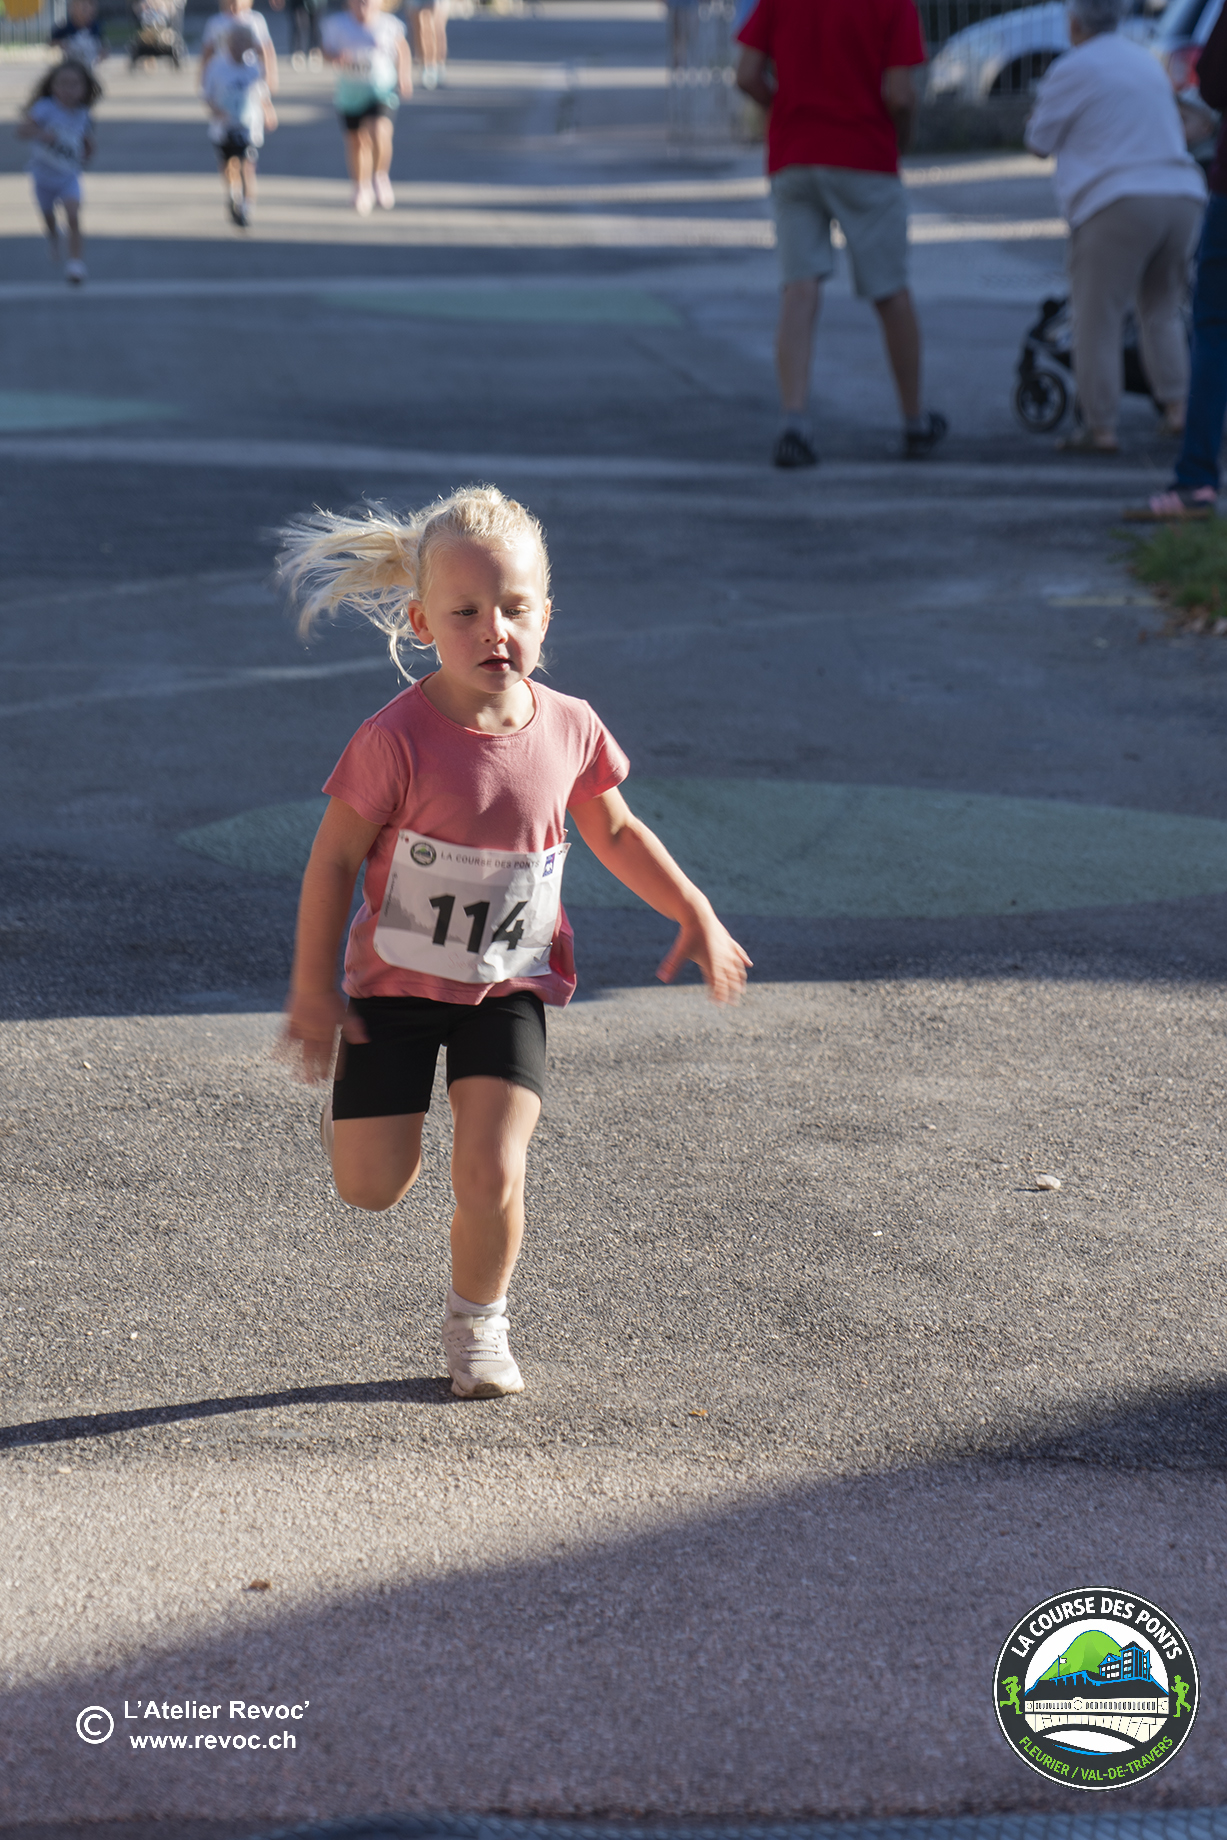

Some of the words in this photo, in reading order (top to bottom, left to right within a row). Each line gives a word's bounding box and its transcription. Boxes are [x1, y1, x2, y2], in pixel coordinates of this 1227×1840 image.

[441, 852, 453, 861] LA
[456, 854, 492, 868] COURSE
[495, 860, 511, 869] DES
[429, 893, 529, 955] 114
